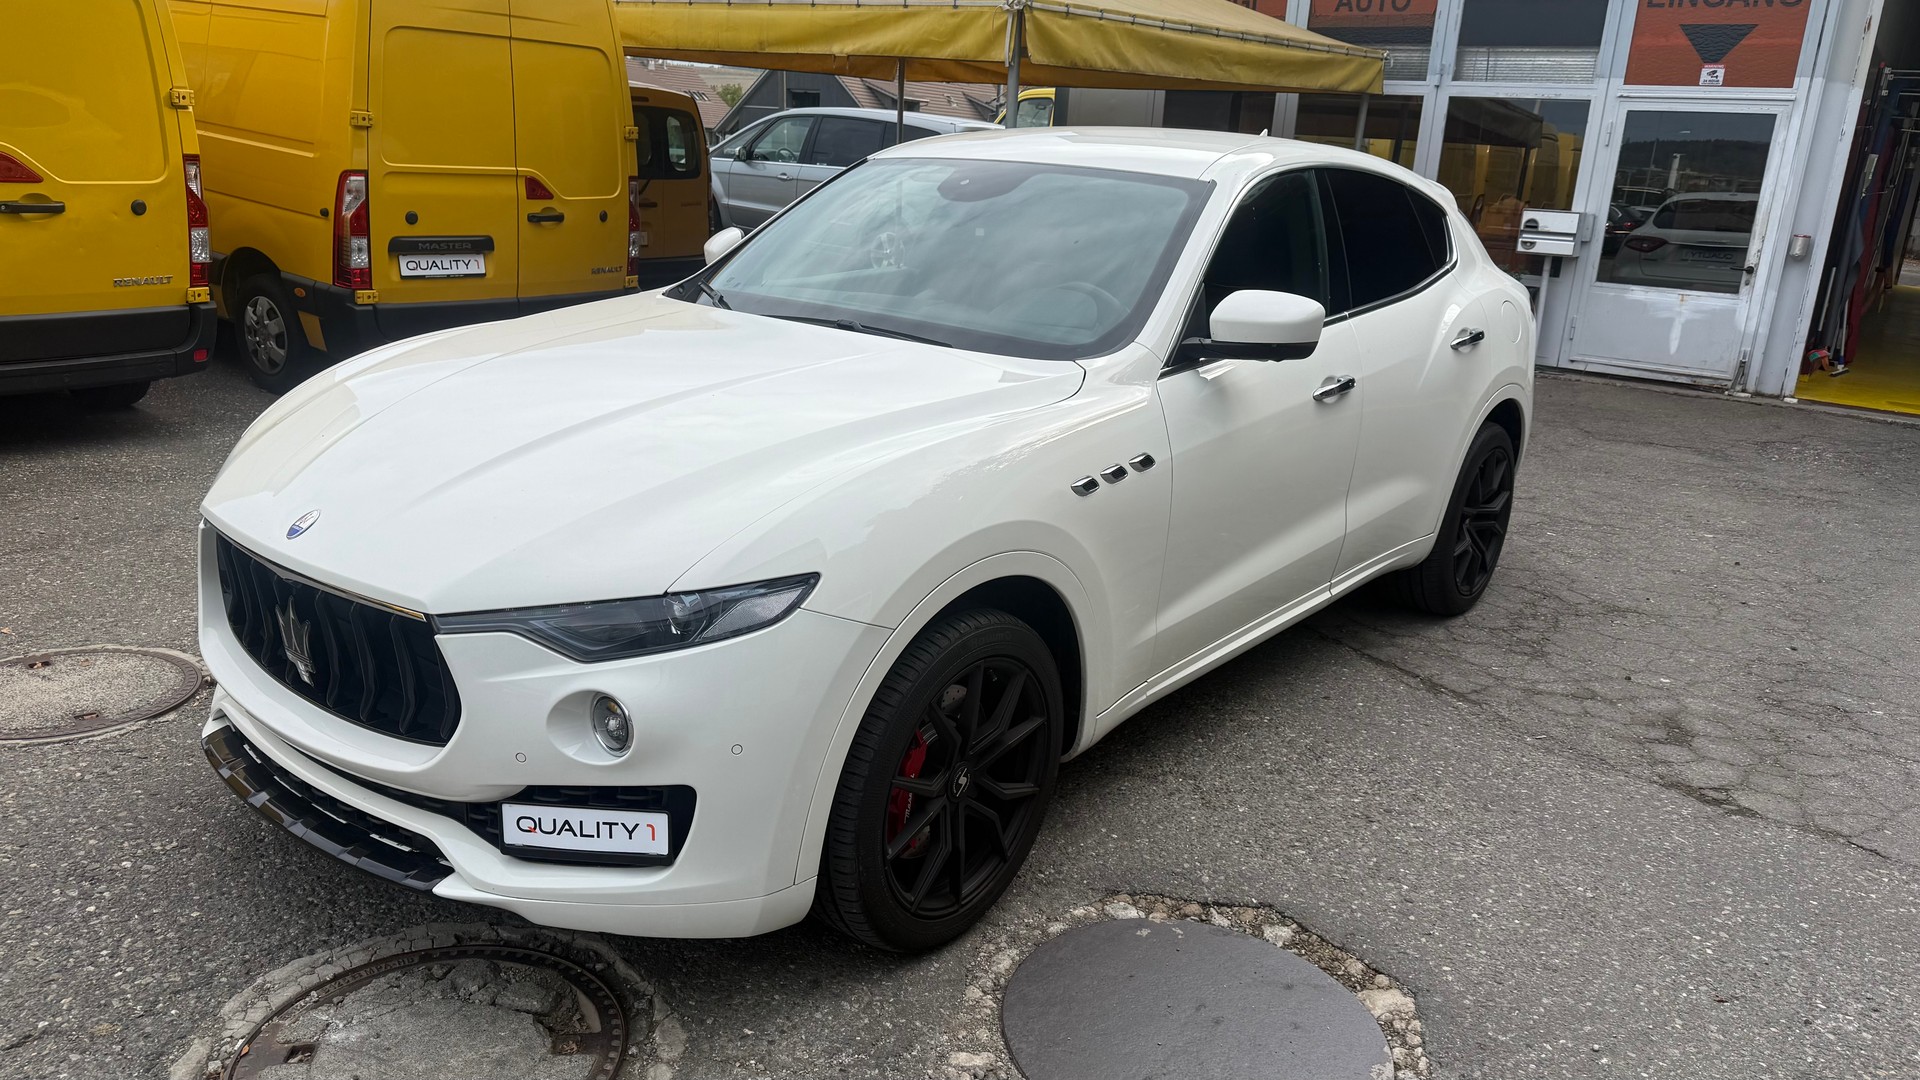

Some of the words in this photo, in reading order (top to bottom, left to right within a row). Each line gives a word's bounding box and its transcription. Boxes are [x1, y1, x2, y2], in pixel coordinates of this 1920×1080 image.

[418, 242, 472, 250] MASTER
[405, 259, 471, 272] QUALITY
[591, 265, 623, 275] RENAULT
[113, 275, 174, 288] RENAULT
[516, 815, 640, 840] QUALITY
[646, 823, 656, 842] 1
